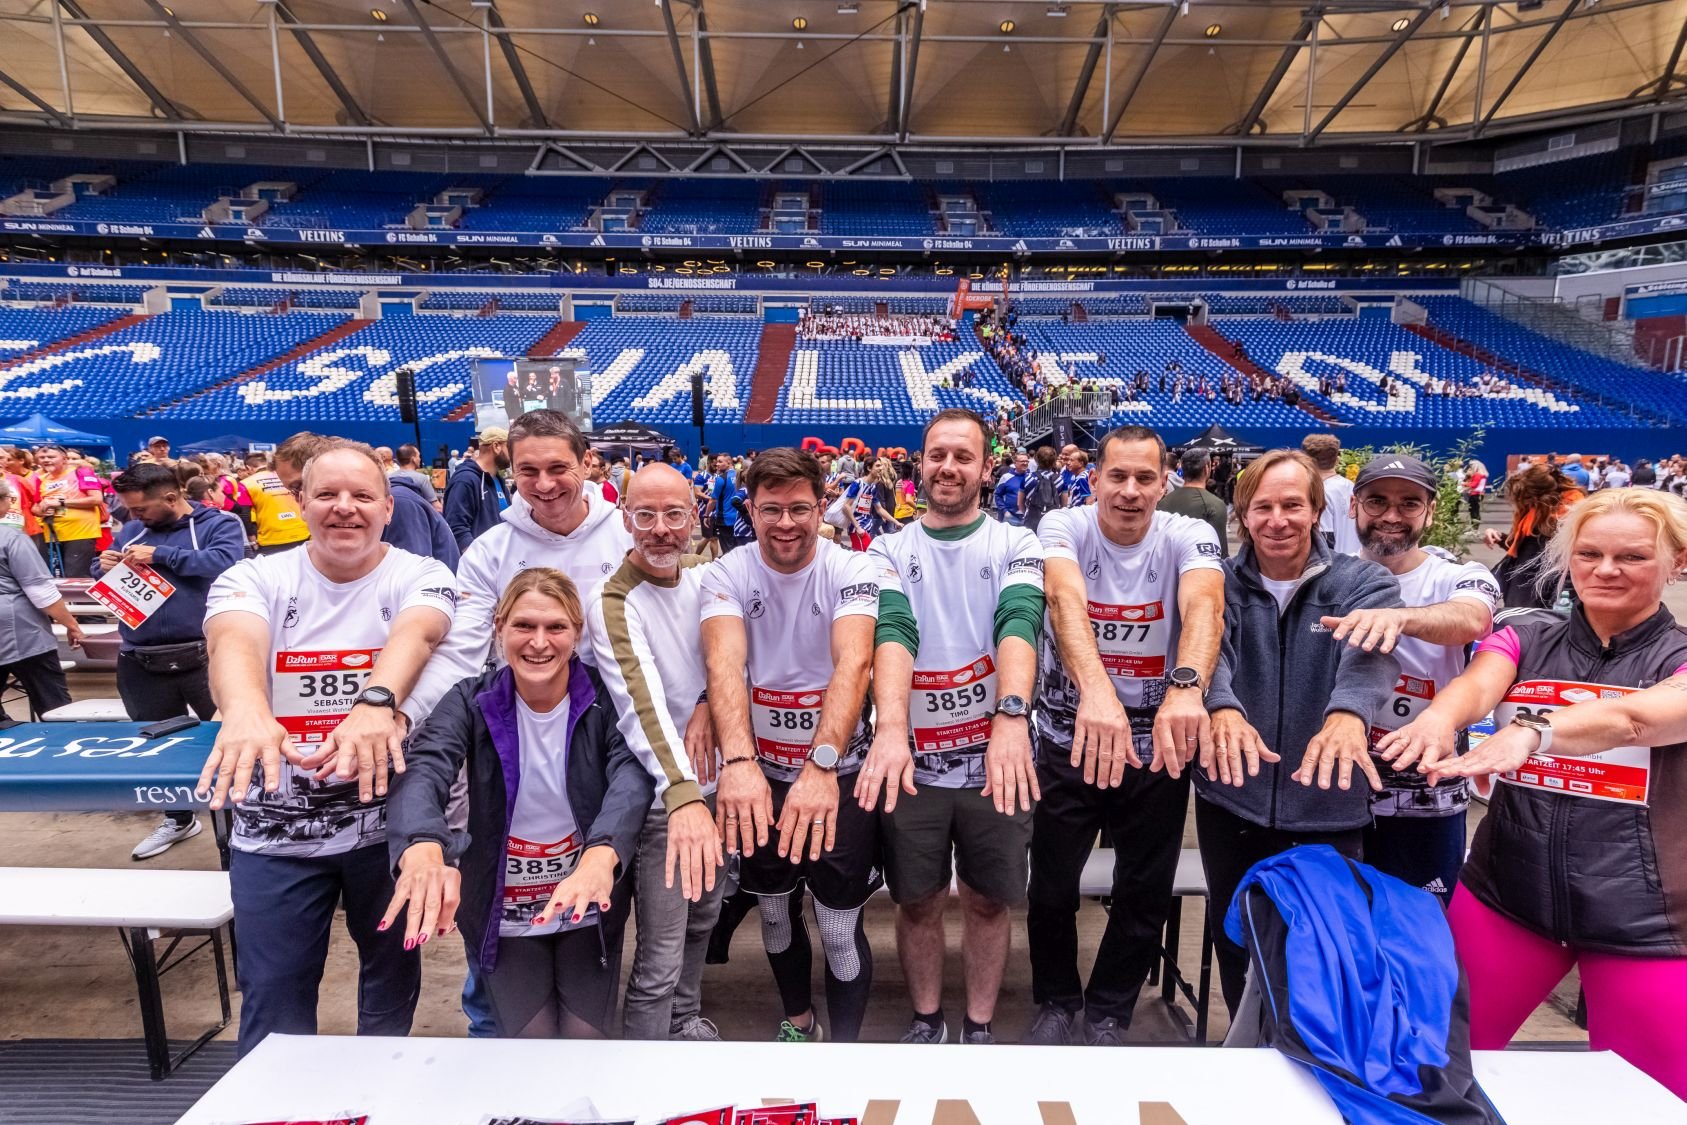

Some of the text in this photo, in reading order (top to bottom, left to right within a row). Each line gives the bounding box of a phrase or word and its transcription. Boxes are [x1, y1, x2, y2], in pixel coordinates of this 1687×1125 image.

[4, 222, 37, 230] SUN
[299, 230, 345, 242] VELTINS
[398, 233, 437, 242] FC Schalke 04
[1541, 228, 1600, 245] VELTINS
[654, 237, 691, 246] FC Schalke 04
[730, 237, 772, 247] VELTINS
[943, 240, 963, 248] Schalke
[964, 240, 972, 248] 04
[1108, 238, 1151, 249] VELTINS
[1200, 238, 1240, 247] FC Schalke 04
[1259, 238, 1322, 246] SUN MINIMEAL
[648, 277, 737, 289] S04.DE/GENOSSENSCHAFT
[971, 280, 1095, 291] DIE KÖNIGSLAUE FÖRDERGENOSSENSCHAFT
[120, 571, 157, 602] 2916
[925, 683, 987, 713] 3859
[950, 709, 969, 719] TIMO
[305, 719, 340, 727] STARTZEIT
[769, 709, 821, 730] 388
[936, 720, 989, 736] STARTZEIT 17:45 Uhr
[1525, 758, 1560, 769] TARTZEIT
[1562, 763, 1586, 773] 17:45
[1588, 767, 1606, 776] Uhr
[507, 849, 581, 875] 3857
[523, 871, 568, 881] CHRISTINE
[1422, 884, 1448, 893] adidas
